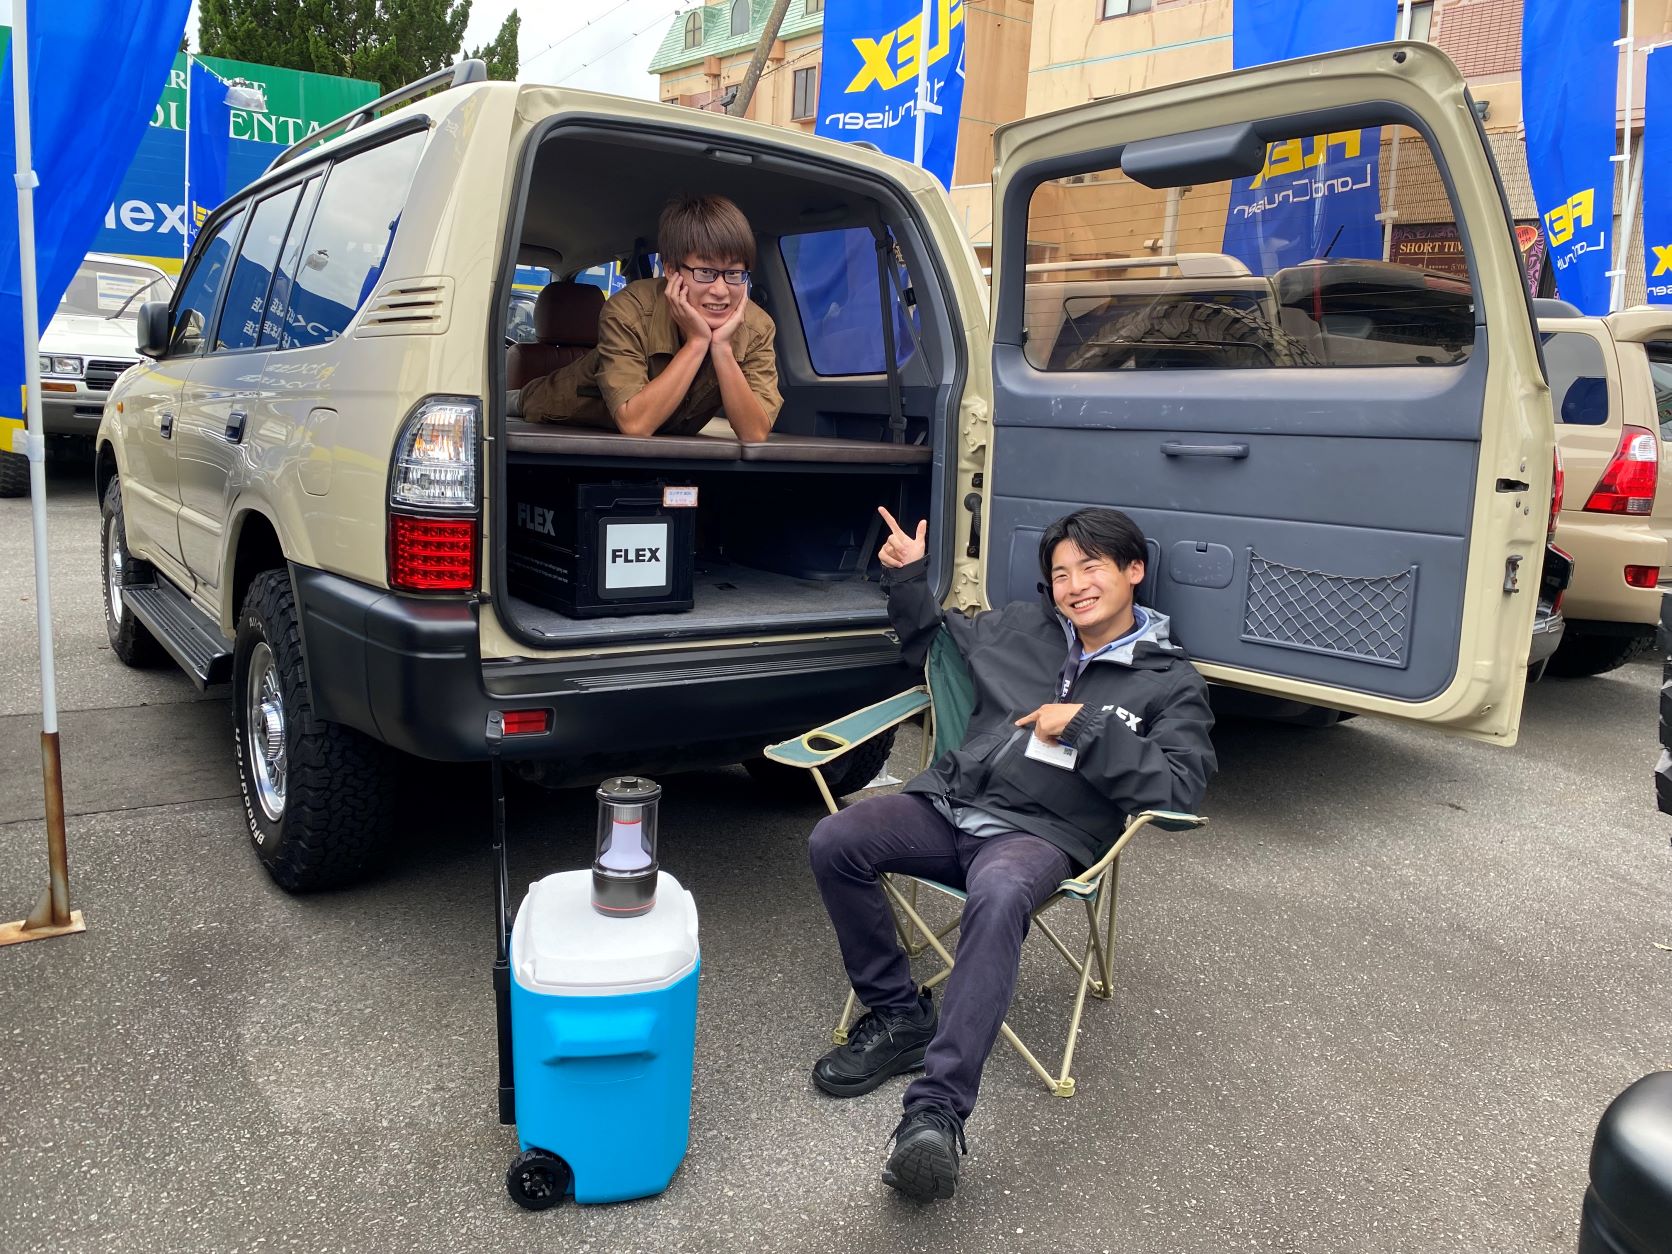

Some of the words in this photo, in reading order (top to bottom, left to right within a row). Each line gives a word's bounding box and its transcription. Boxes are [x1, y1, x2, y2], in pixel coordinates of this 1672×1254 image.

[1400, 242, 1442, 253] SHORT
[517, 502, 556, 537] FLEX
[611, 547, 661, 564] FLEX
